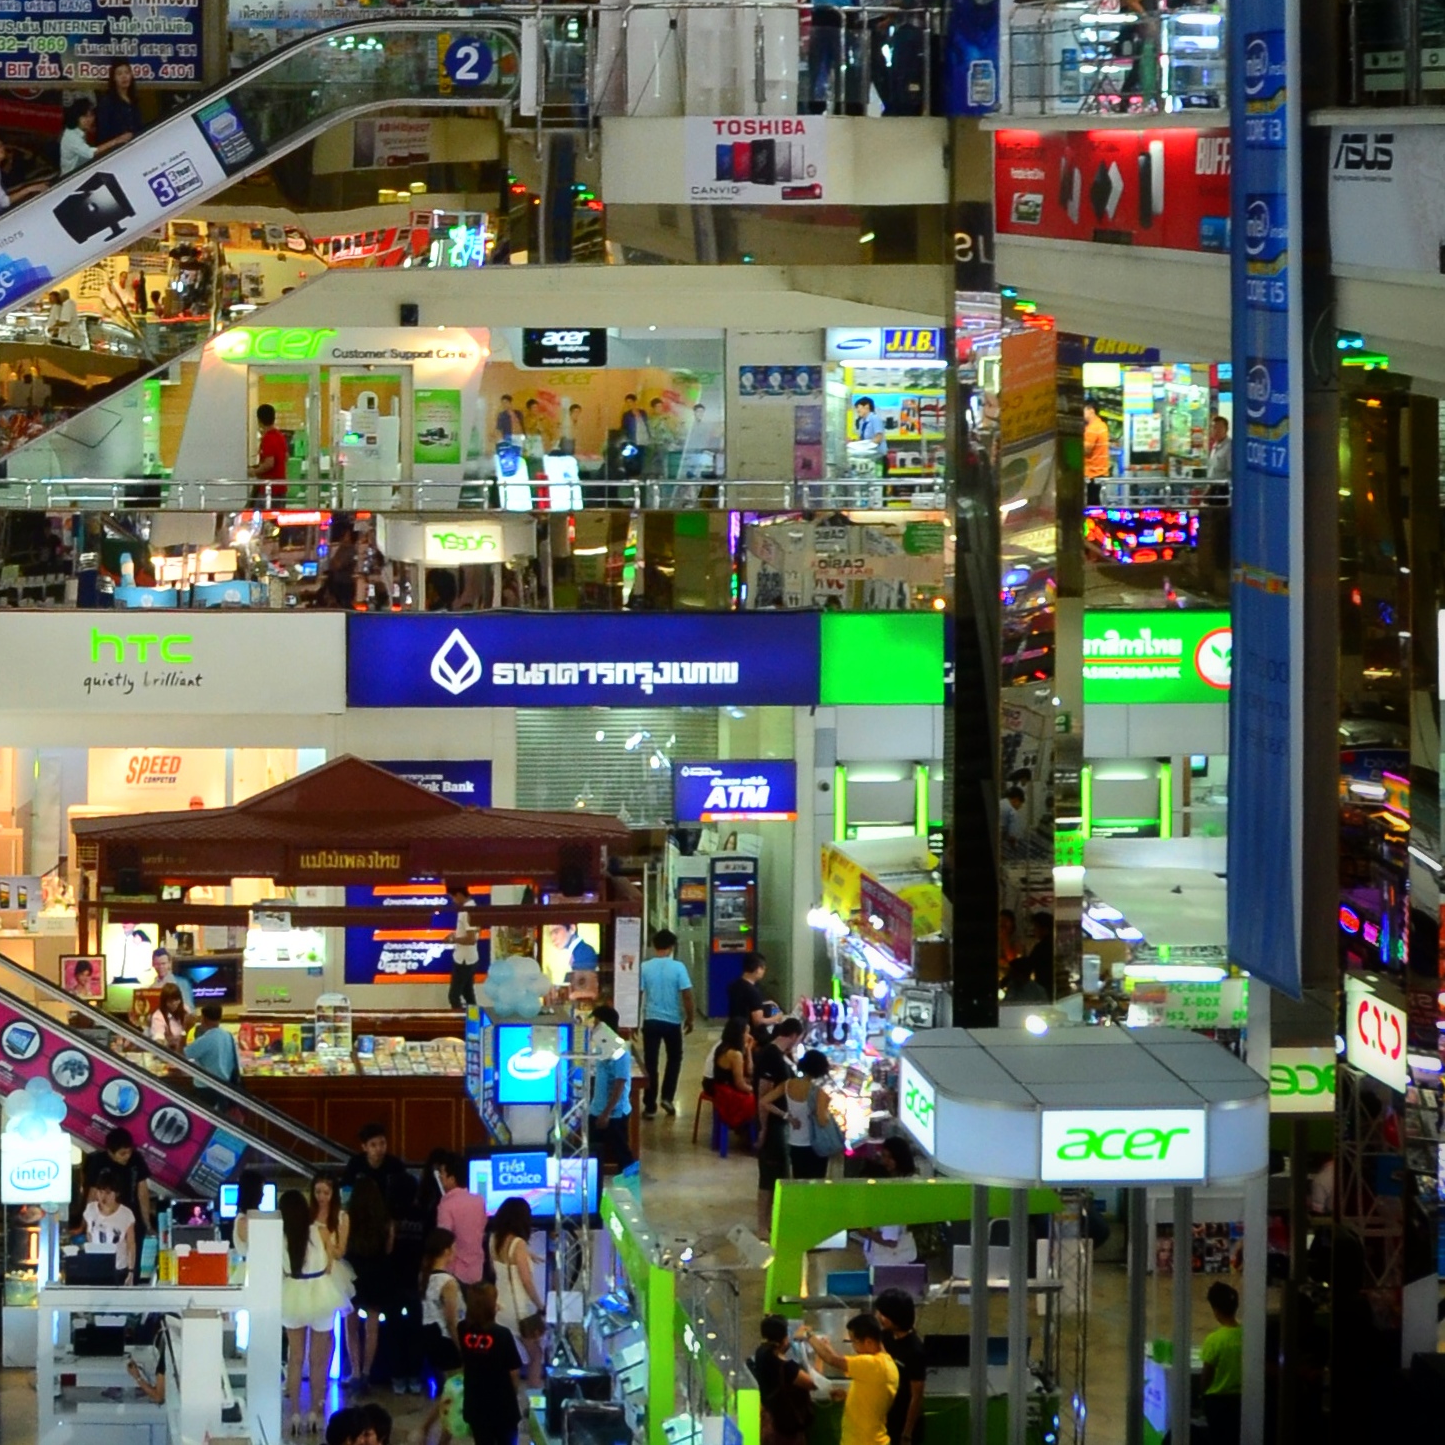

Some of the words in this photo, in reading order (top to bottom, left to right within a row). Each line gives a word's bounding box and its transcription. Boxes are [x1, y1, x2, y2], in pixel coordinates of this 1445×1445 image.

[42, 19, 107, 35] INTERNET
[6, 61, 32, 79] BIT
[64, 61, 76, 79] 4
[79, 61, 112, 79] Roo
[159, 61, 196, 79] 4101
[455, 43, 480, 80] 2
[712, 119, 806, 136] TOSHIBA
[1268, 118, 1282, 141] i3
[1333, 133, 1395, 171] ASUS
[1269, 281, 1285, 304] i5
[215, 326, 337, 363] acer
[540, 330, 592, 347] acer
[885, 328, 938, 354] J.I.B.
[332, 347, 389, 361] Customer
[390, 347, 434, 364] Support
[1269, 445, 1286, 468] i7
[83, 672, 135, 696] quietly
[143, 670, 205, 688] brilliant
[492, 661, 739, 695] ธนาคารกรุงเทพ
[1083, 666, 1182, 680] ASIKORNBANK
[125, 754, 183, 785] SPEED
[441, 780, 476, 793] Bank
[703, 784, 770, 810] ATM
[904, 1077, 934, 1129] acer
[1056, 1127, 1191, 1161] acer
[498, 1158, 527, 1175] First
[498, 1172, 542, 1186] Choice
